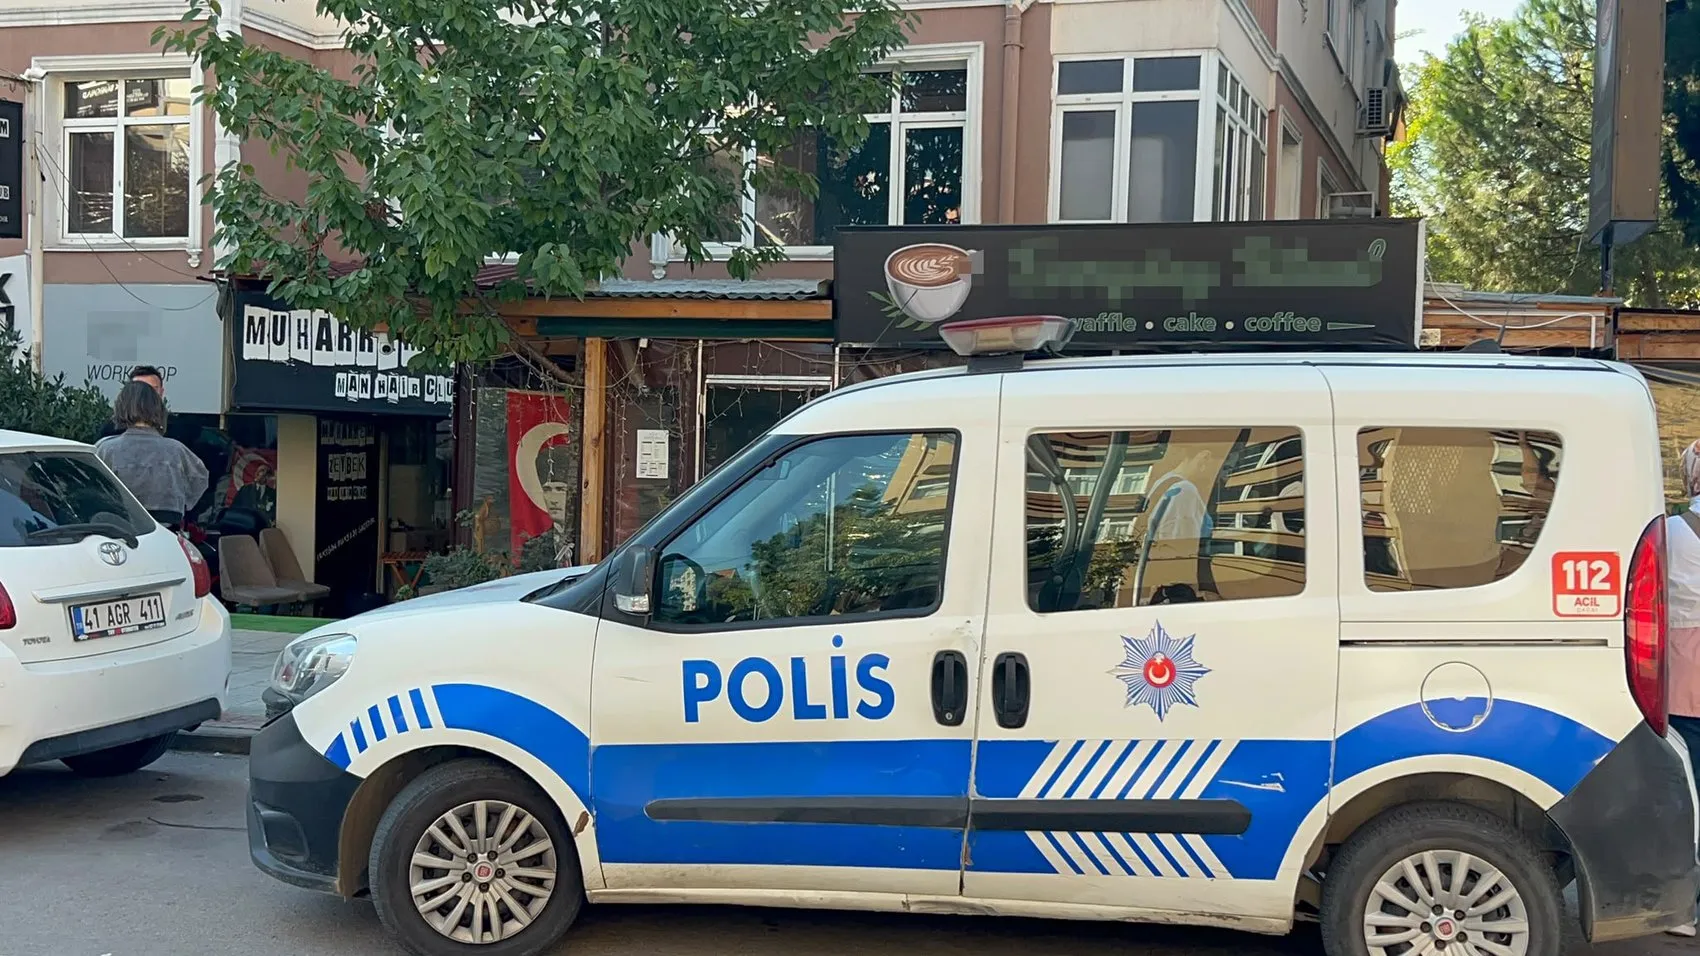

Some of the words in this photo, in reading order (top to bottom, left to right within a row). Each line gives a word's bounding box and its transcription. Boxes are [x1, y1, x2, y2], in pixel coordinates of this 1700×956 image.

[1163, 312, 1217, 332] cake
[1244, 312, 1322, 332] coffee
[246, 315, 424, 354] MUHARR
[87, 364, 178, 382] WORKOP
[337, 375, 369, 394] MAN
[1562, 559, 1611, 590] 112
[85, 606, 100, 630] 41
[107, 602, 131, 626] AGR
[140, 598, 160, 620] 411
[22, 636, 51, 646] TOYOTA
